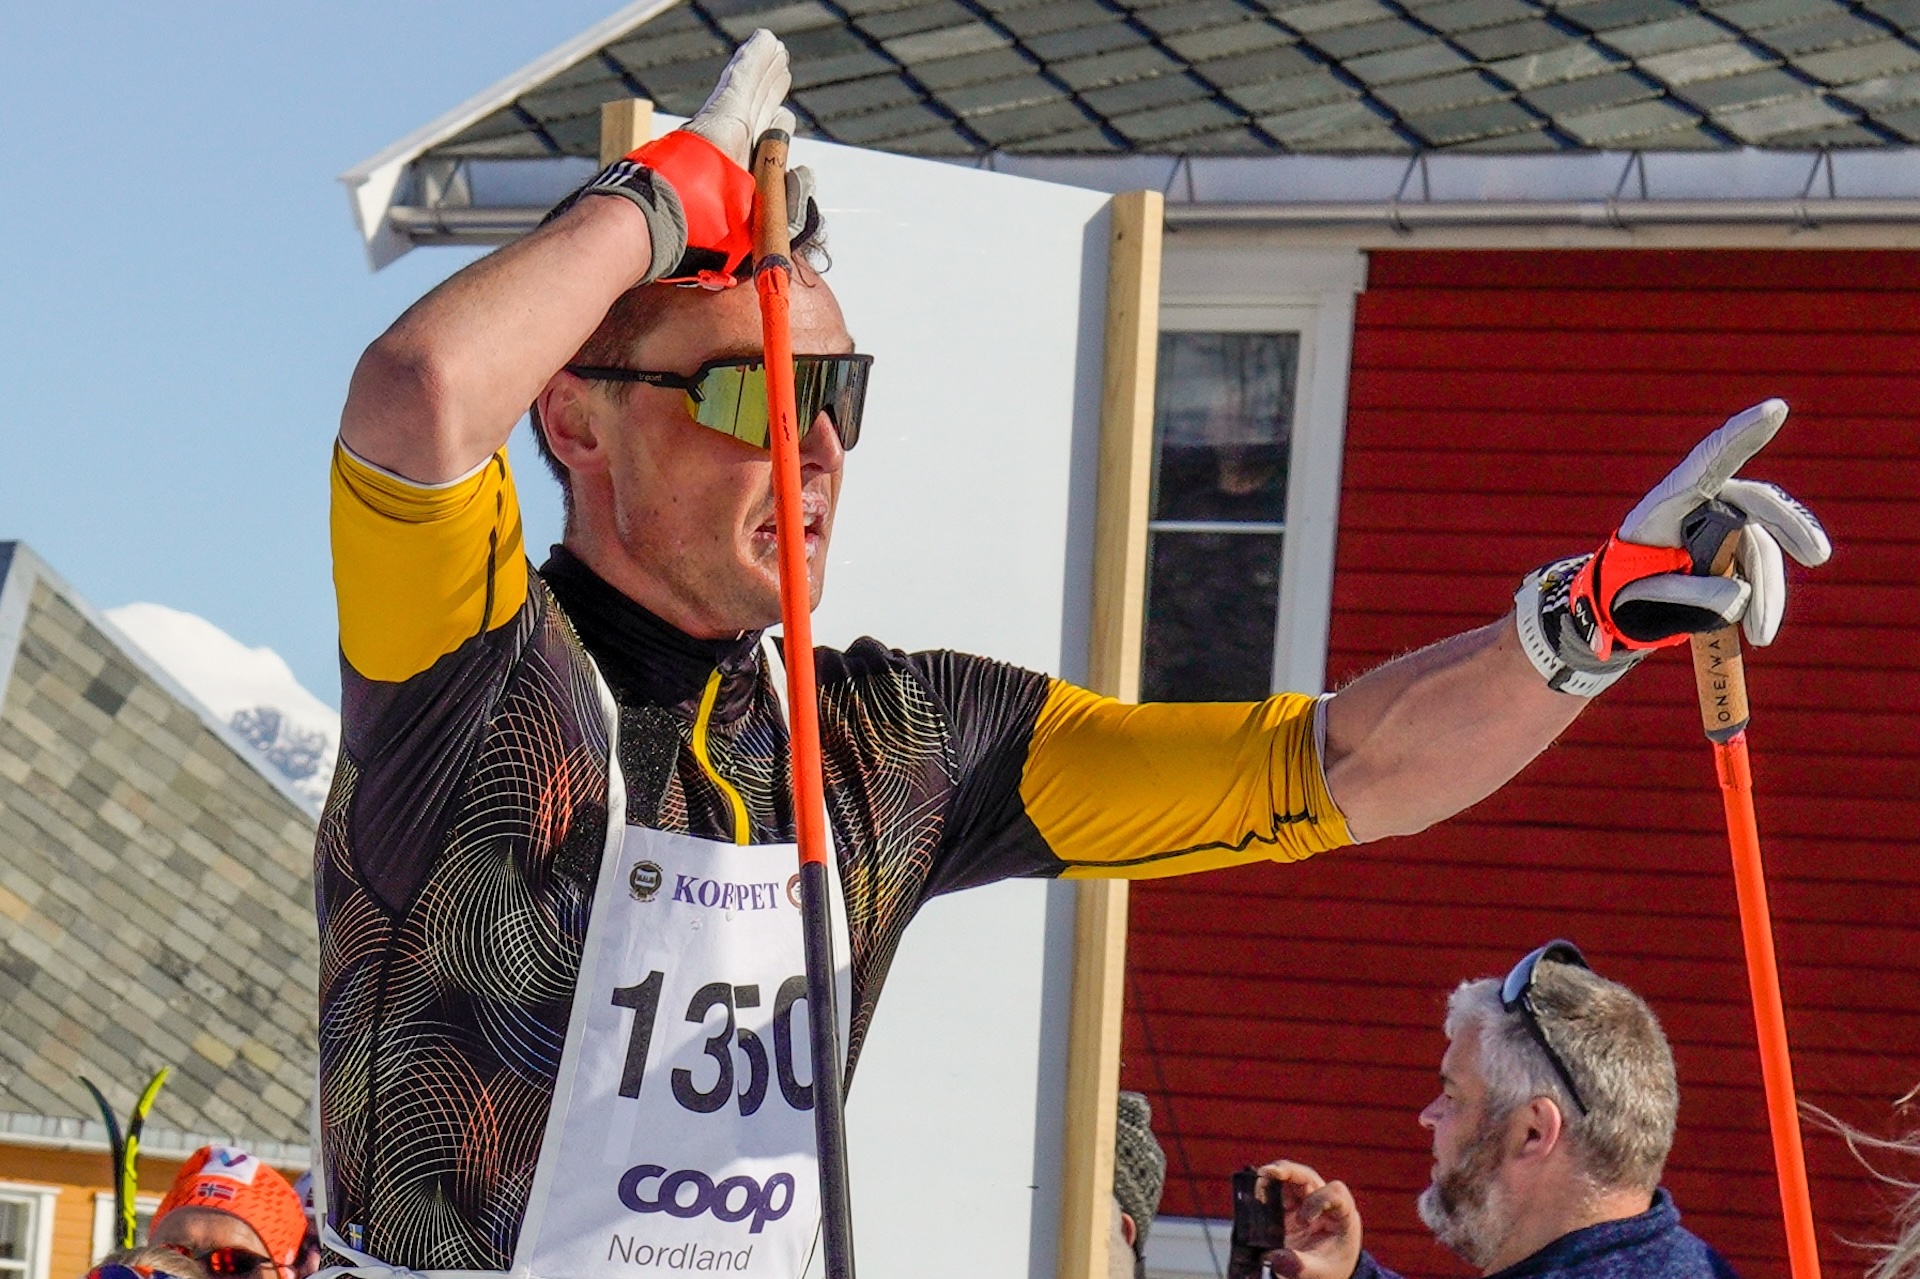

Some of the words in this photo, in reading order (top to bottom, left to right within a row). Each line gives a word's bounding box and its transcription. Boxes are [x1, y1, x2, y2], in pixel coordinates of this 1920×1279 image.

[1707, 638, 1731, 722] ONE/WA
[617, 1163, 796, 1234] coop
[608, 1233, 754, 1272] Nordland
